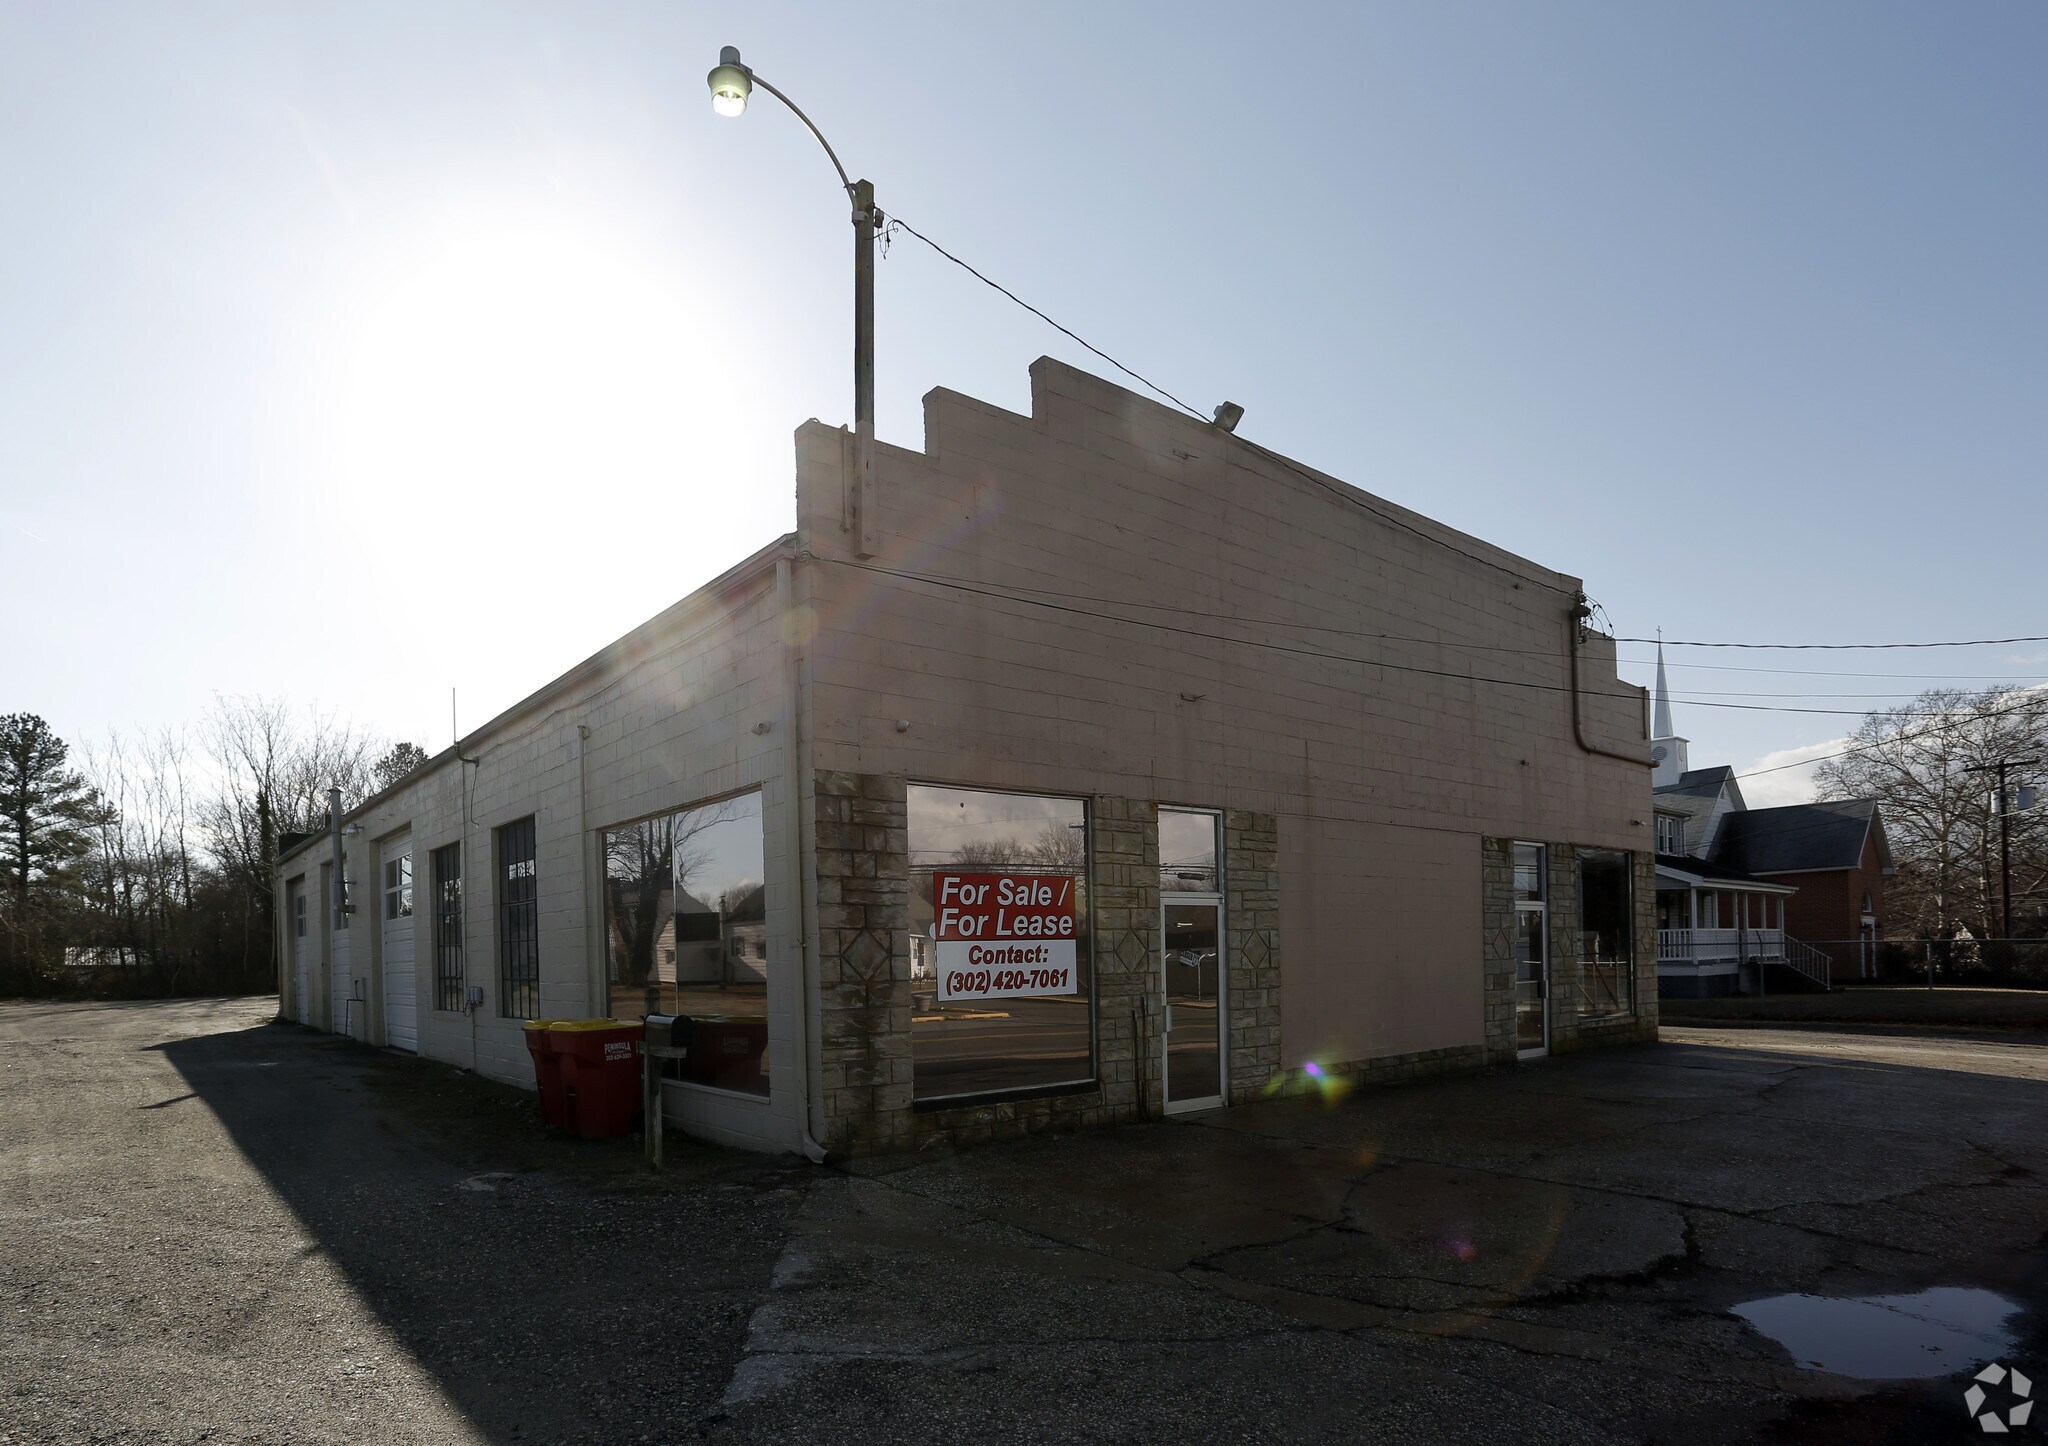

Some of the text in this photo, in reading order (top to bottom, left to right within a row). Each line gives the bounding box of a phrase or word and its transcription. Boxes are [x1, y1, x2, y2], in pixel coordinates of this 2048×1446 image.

[940, 877, 1070, 907] For Sale /
[939, 908, 1073, 937] For Lease
[968, 944, 1049, 965] Contact:
